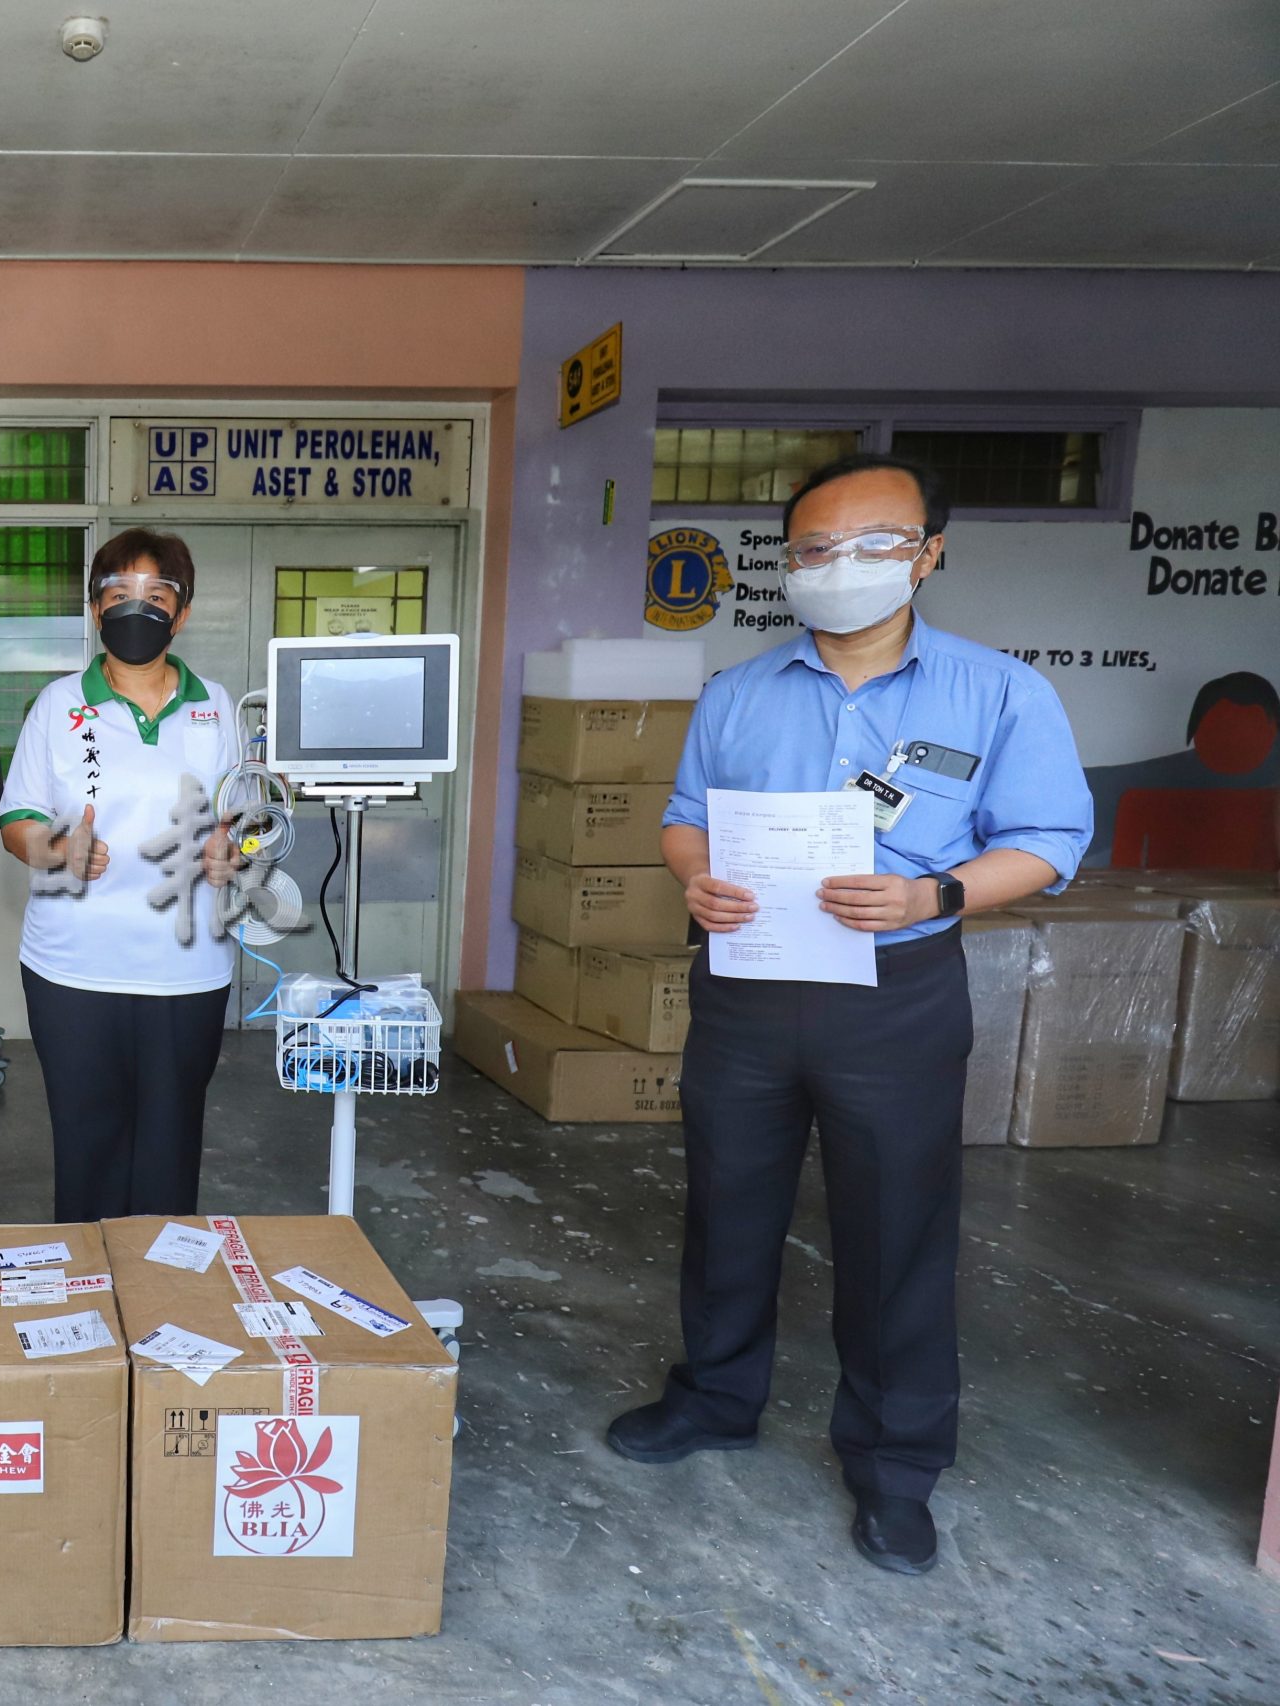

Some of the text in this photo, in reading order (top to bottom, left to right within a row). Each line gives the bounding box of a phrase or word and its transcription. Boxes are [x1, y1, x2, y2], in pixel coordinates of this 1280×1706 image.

[227, 429, 440, 467] UNIT PEROLEHAN,
[252, 466, 412, 497] ASET & STOR
[656, 531, 709, 550] LIONS
[740, 530, 783, 551] Spon
[1129, 511, 1280, 551] Donate B
[666, 559, 697, 598] L
[1147, 555, 1268, 595] Donate
[735, 582, 786, 602] Distri
[733, 609, 794, 631] Region
[1047, 650, 1074, 666] TO
[1080, 650, 1093, 667] 3
[863, 778, 873, 788] DR
[223, 1229, 249, 1260] FRAGILE
[297, 1368, 313, 1416] FRAGI
[240, 1501, 296, 1519] 佛光
[241, 1521, 309, 1537] BLIA
